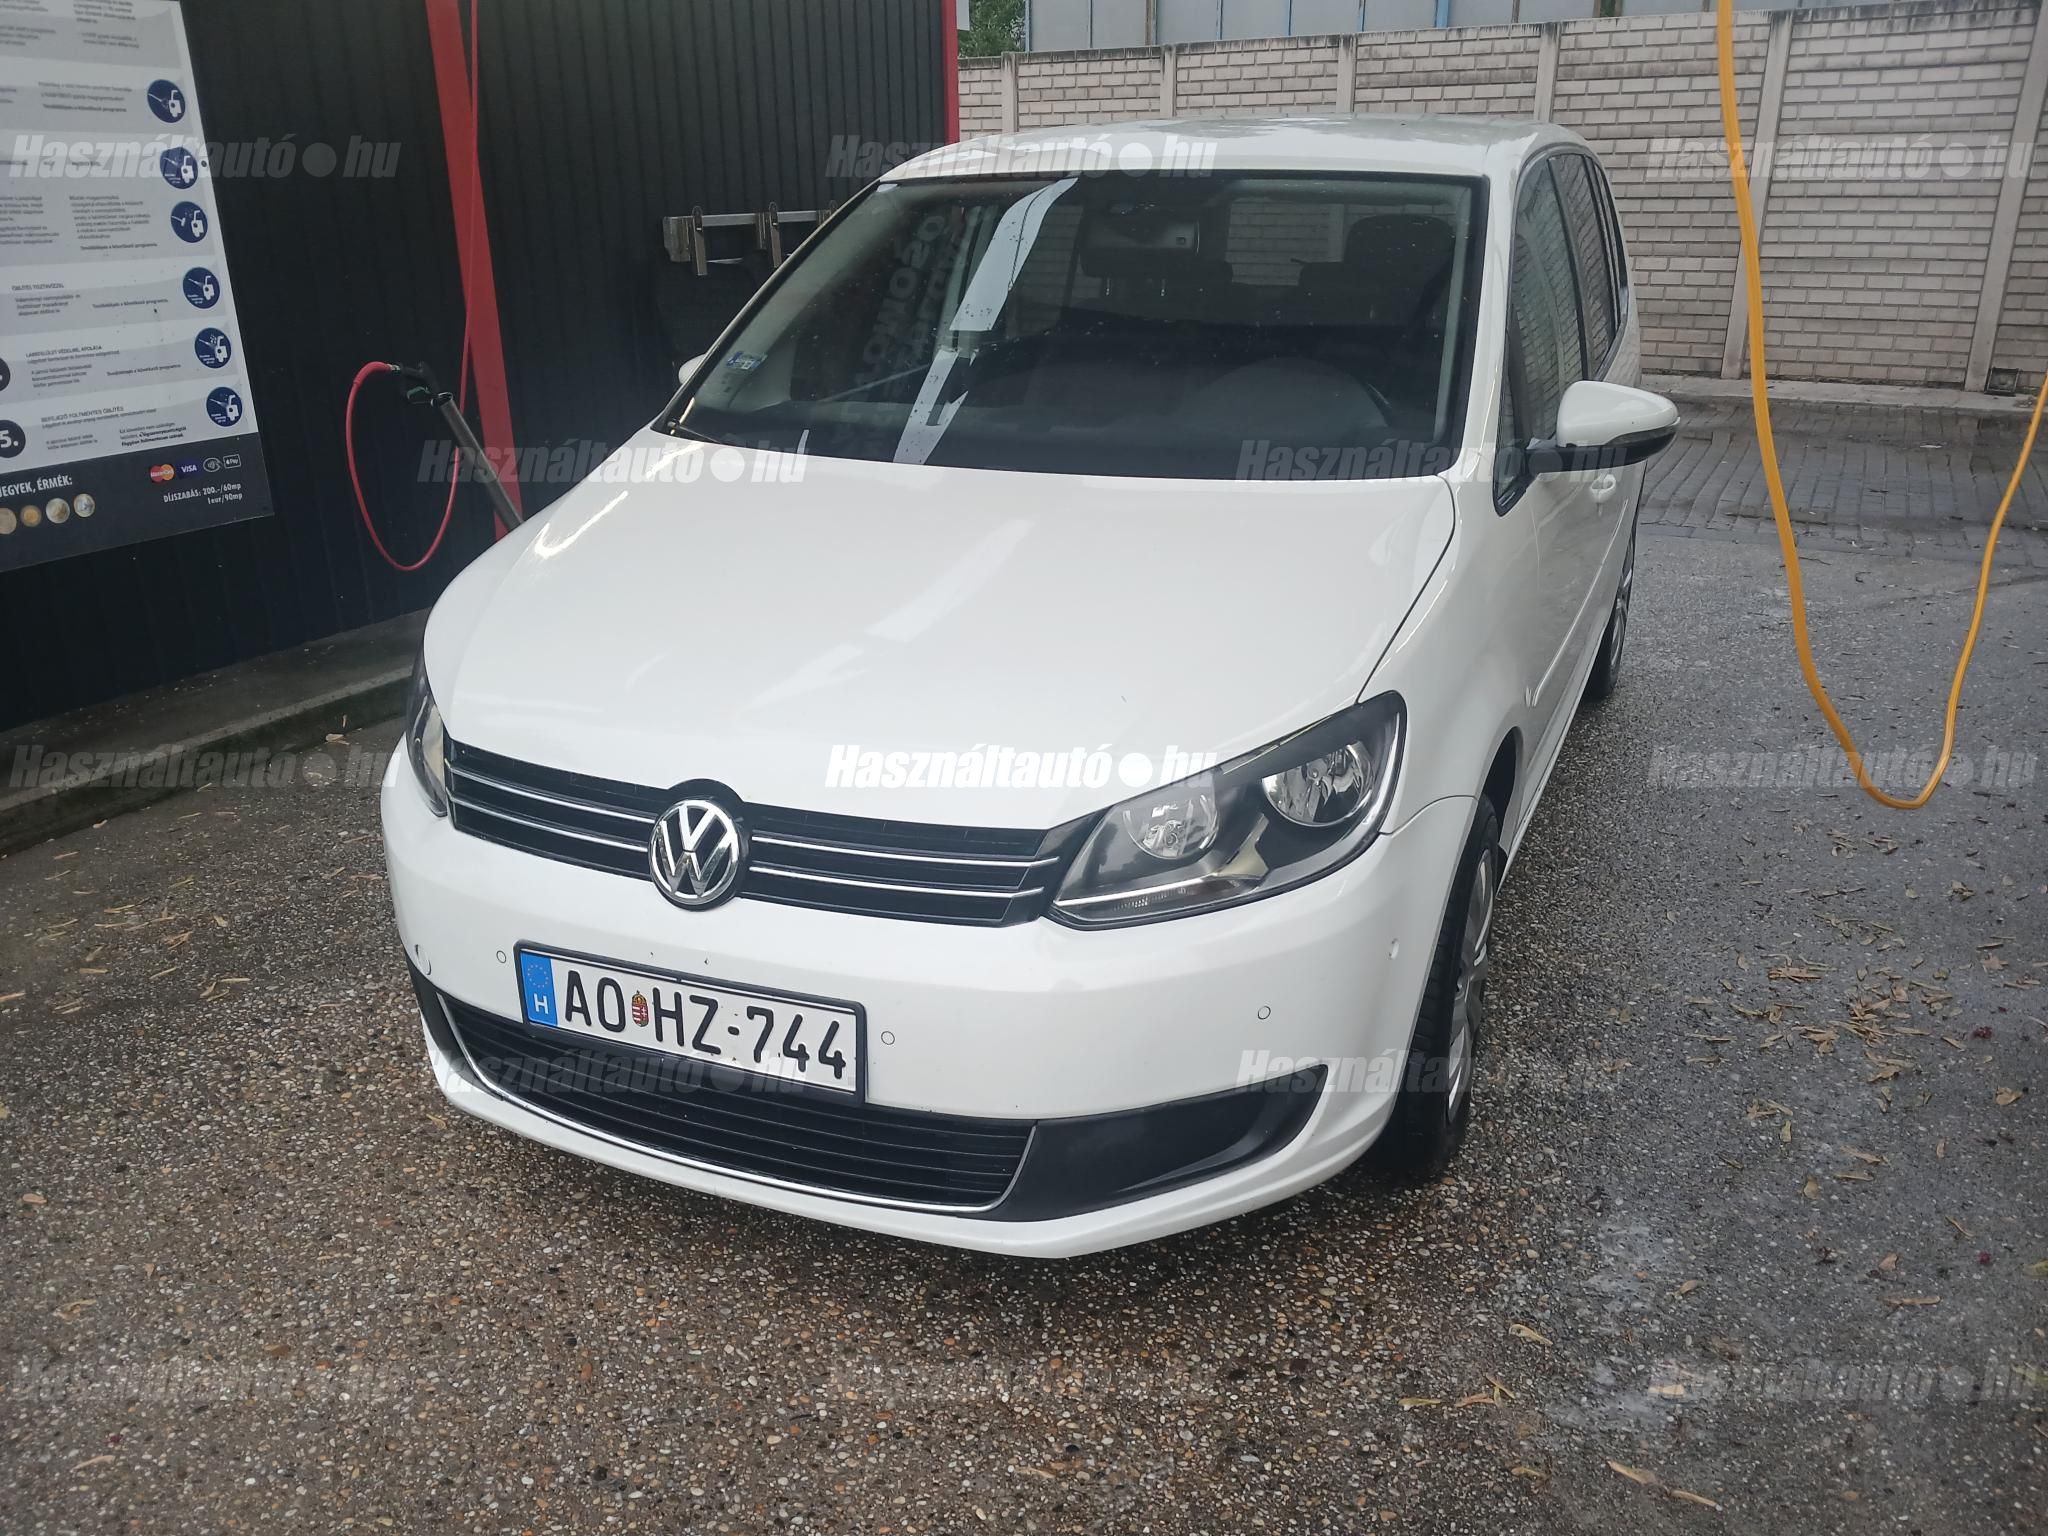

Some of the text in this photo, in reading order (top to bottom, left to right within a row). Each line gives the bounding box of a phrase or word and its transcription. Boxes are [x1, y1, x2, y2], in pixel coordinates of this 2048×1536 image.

[181, 464, 198, 473] VISA
[36, 475, 73, 491] ÉRMÉK:
[163, 487, 201, 503] DÍJSZABÁS:
[533, 993, 549, 1015] H
